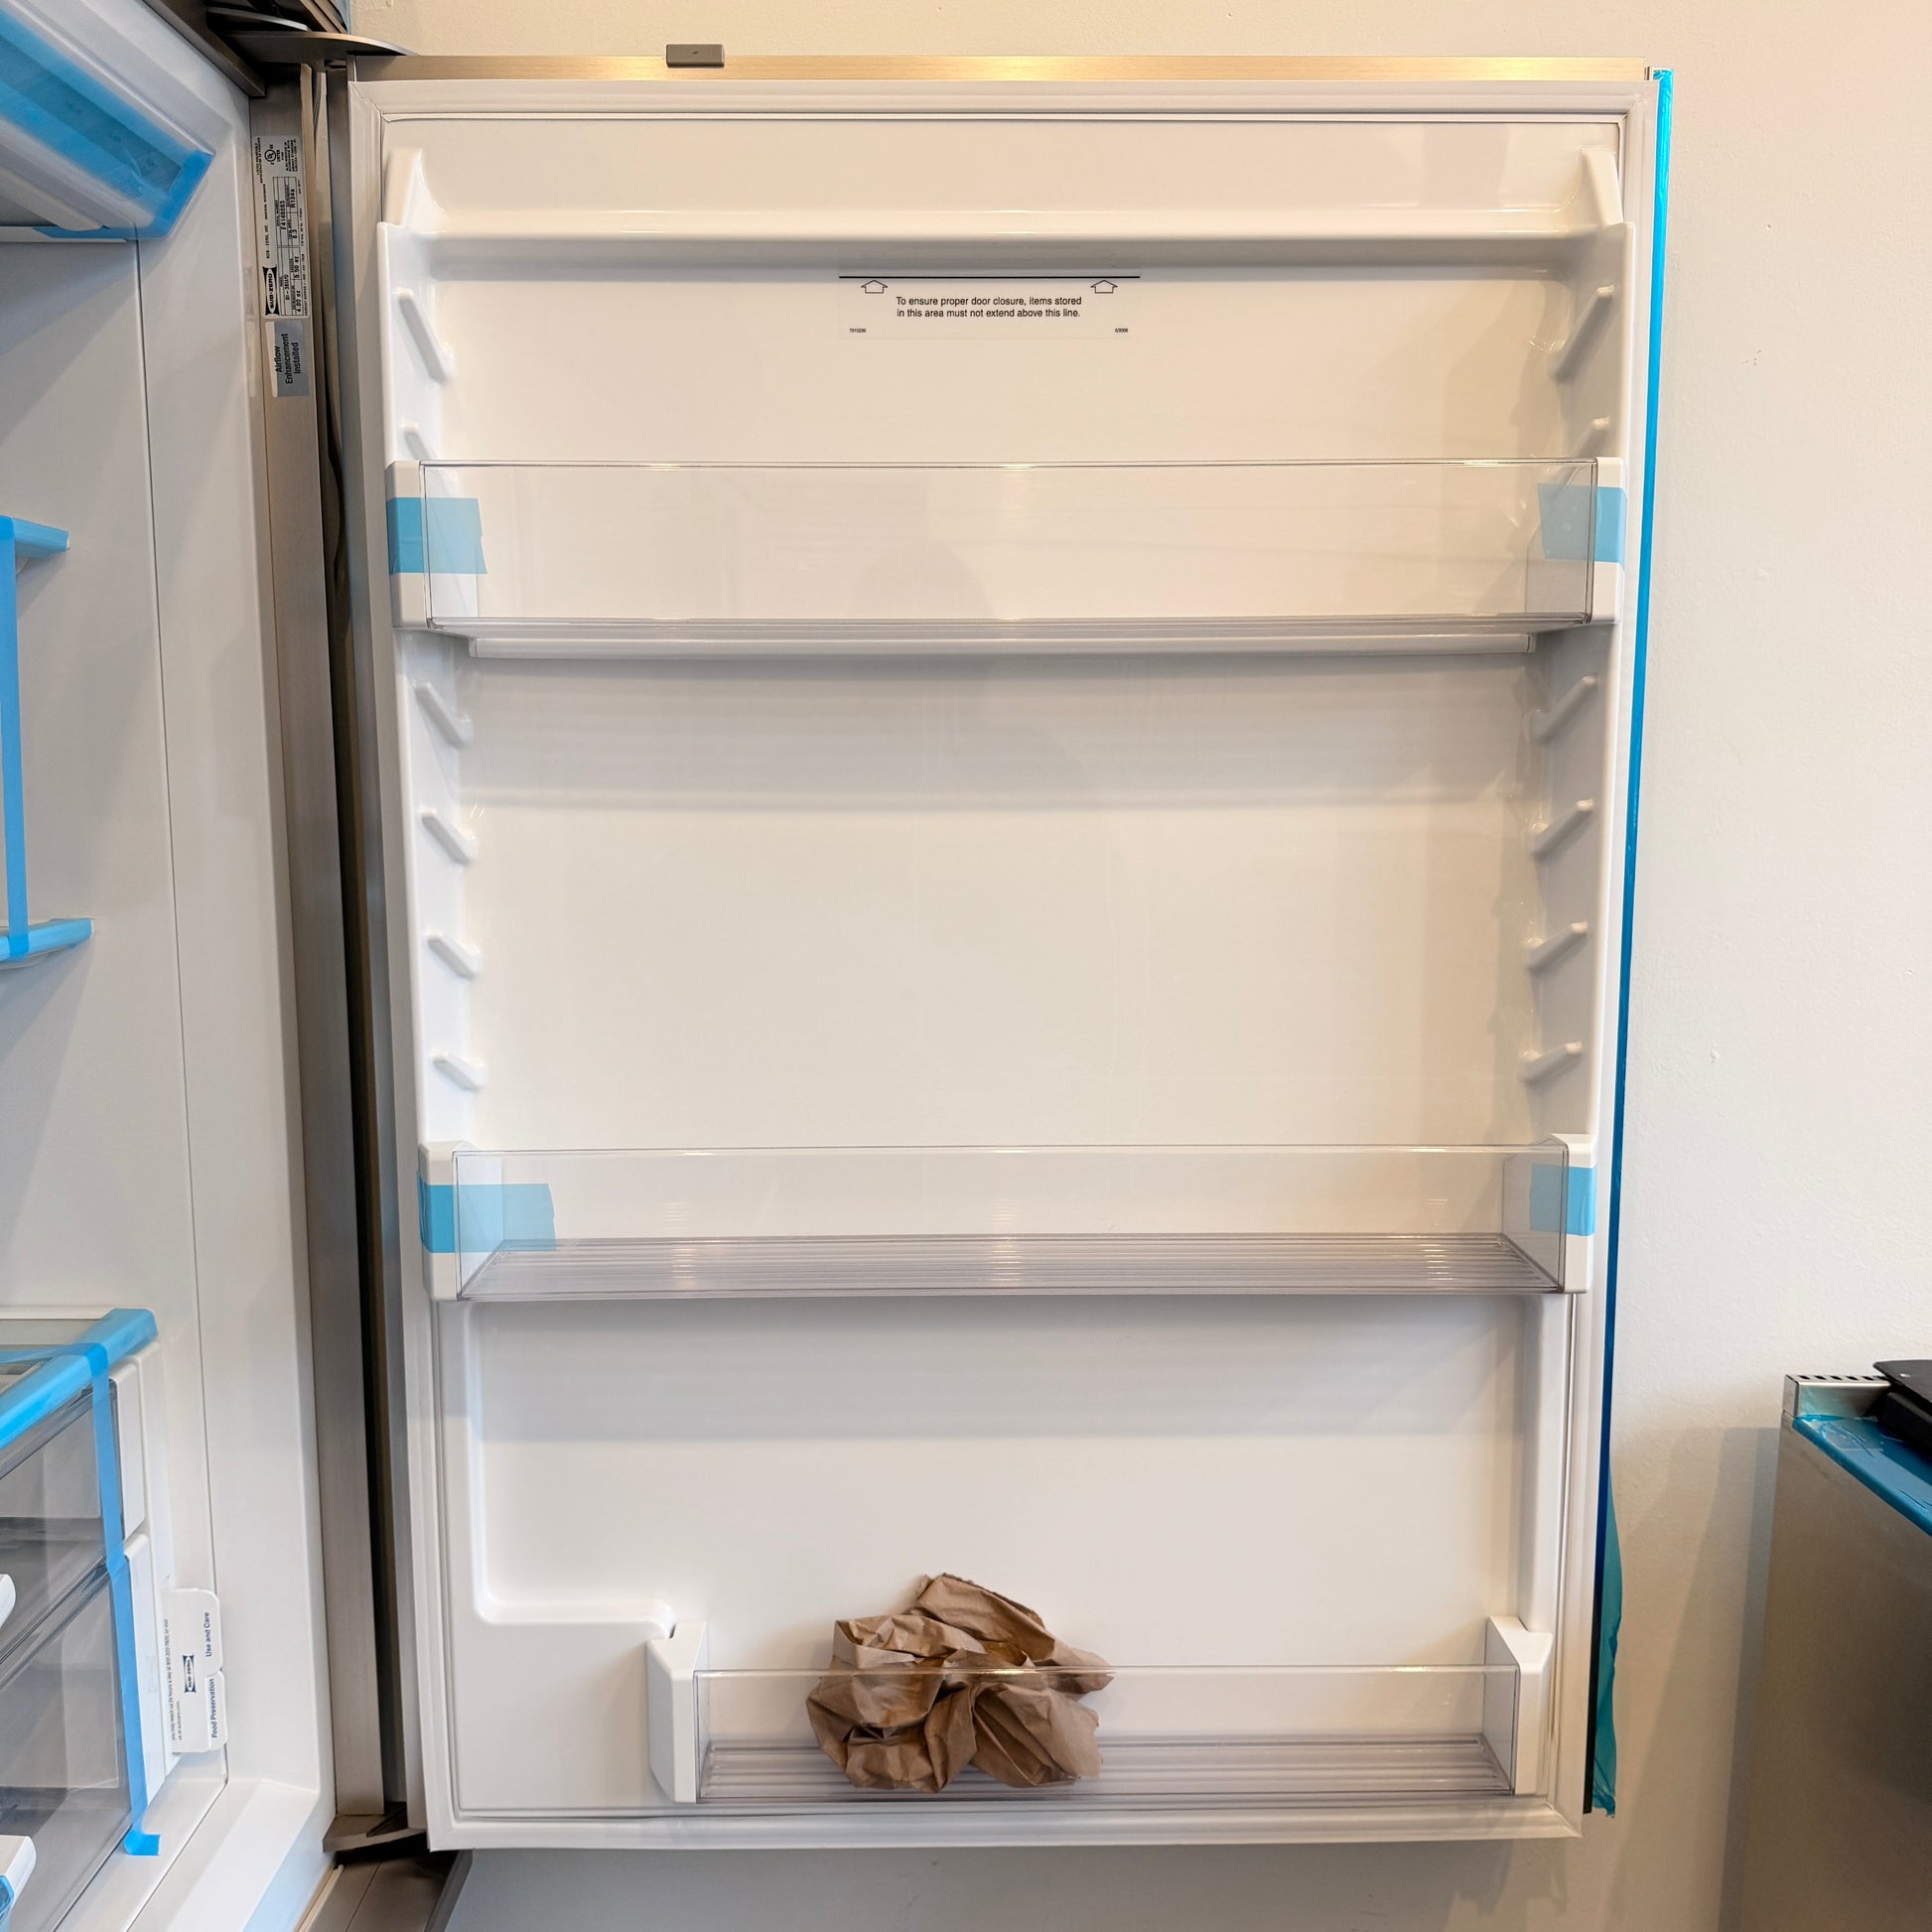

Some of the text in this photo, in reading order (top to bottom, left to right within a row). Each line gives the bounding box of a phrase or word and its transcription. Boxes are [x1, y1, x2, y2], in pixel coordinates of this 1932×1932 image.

[896, 296, 906, 306] To
[940, 298, 969, 308] proper
[971, 296, 991, 306] door
[993, 296, 1027, 307] closure,
[1029, 296, 1052, 306] items
[1054, 296, 1081, 306] stored
[897, 308, 904, 318] in
[907, 308, 922, 318] this
[946, 309, 968, 318] must
[970, 309, 983, 318] not
[986, 309, 1015, 318] extend
[1017, 309, 1042, 318] above
[1045, 309, 1060, 318] this
[1062, 309, 1081, 318] line.
[281, 334, 293, 384] Enhancement
[291, 343, 301, 373] Installed
